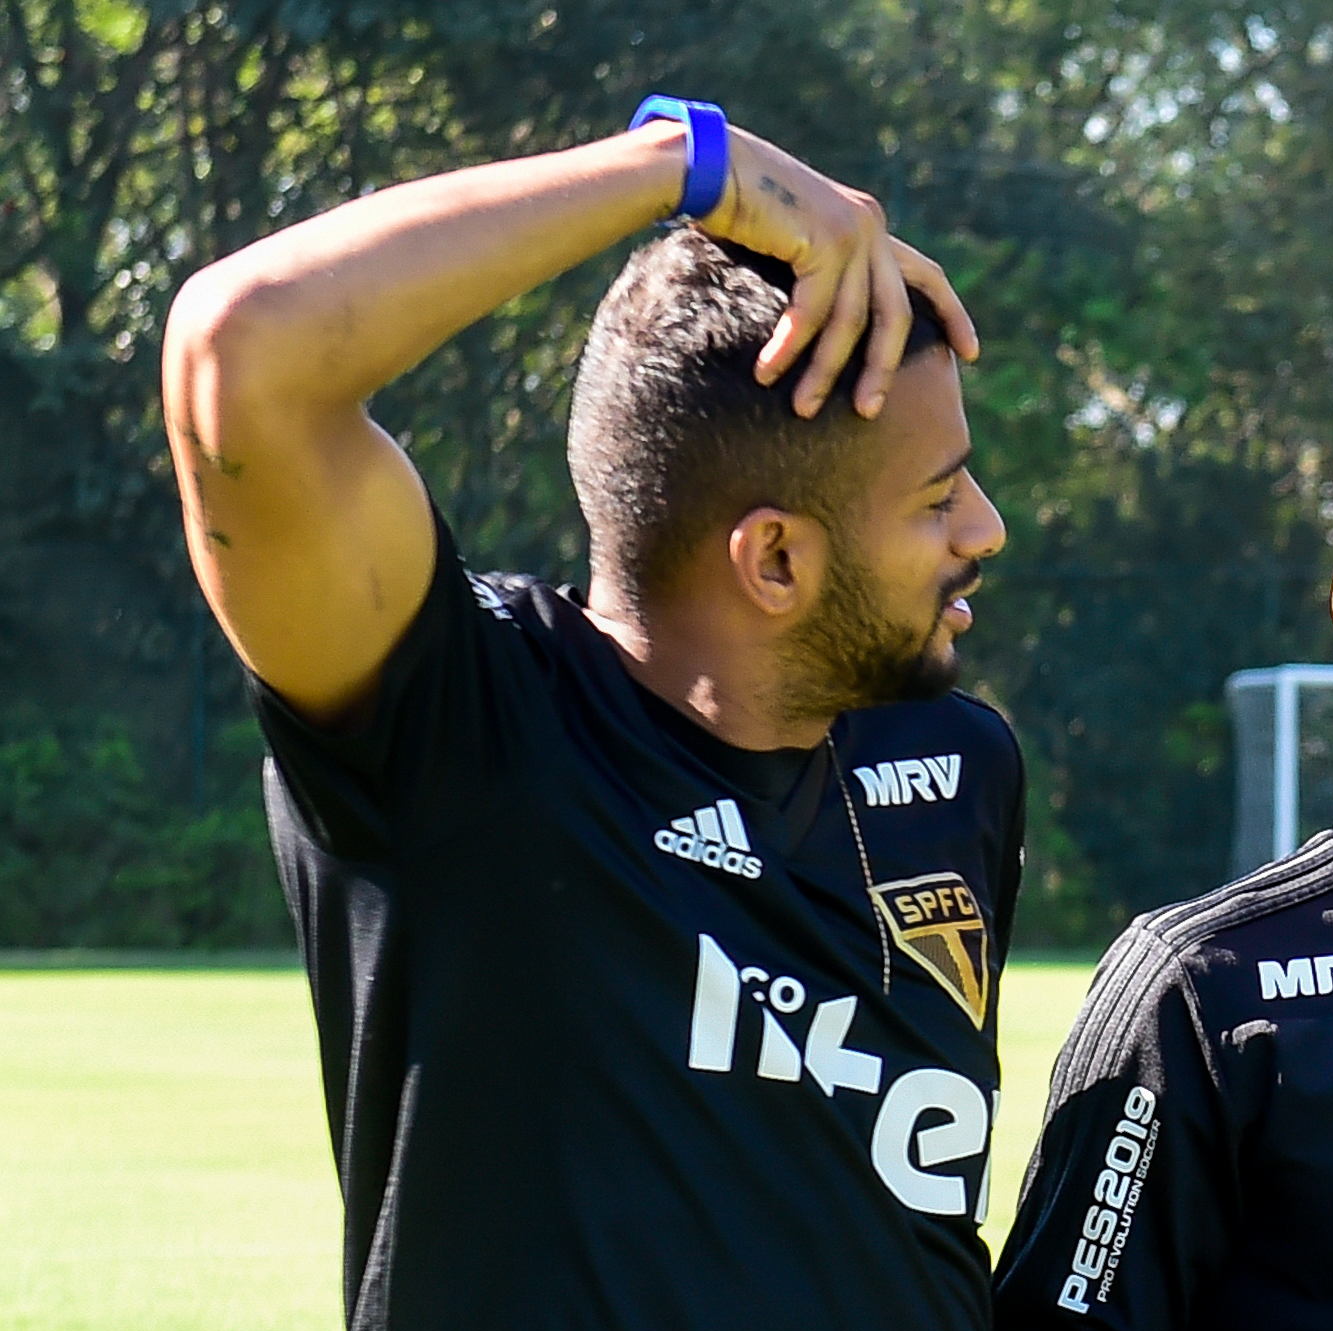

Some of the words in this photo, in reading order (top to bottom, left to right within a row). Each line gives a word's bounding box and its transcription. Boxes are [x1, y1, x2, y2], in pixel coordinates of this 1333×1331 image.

[853, 754, 961, 806] MRV
[654, 830, 762, 879] adidas
[894, 886, 975, 923] SPFC
[1057, 1086, 1157, 1314] PES2019
[1096, 1269, 1117, 1302] PRO
[1107, 1179, 1145, 1268] EVOLUTION
[1136, 1118, 1162, 1179] SOCCER
